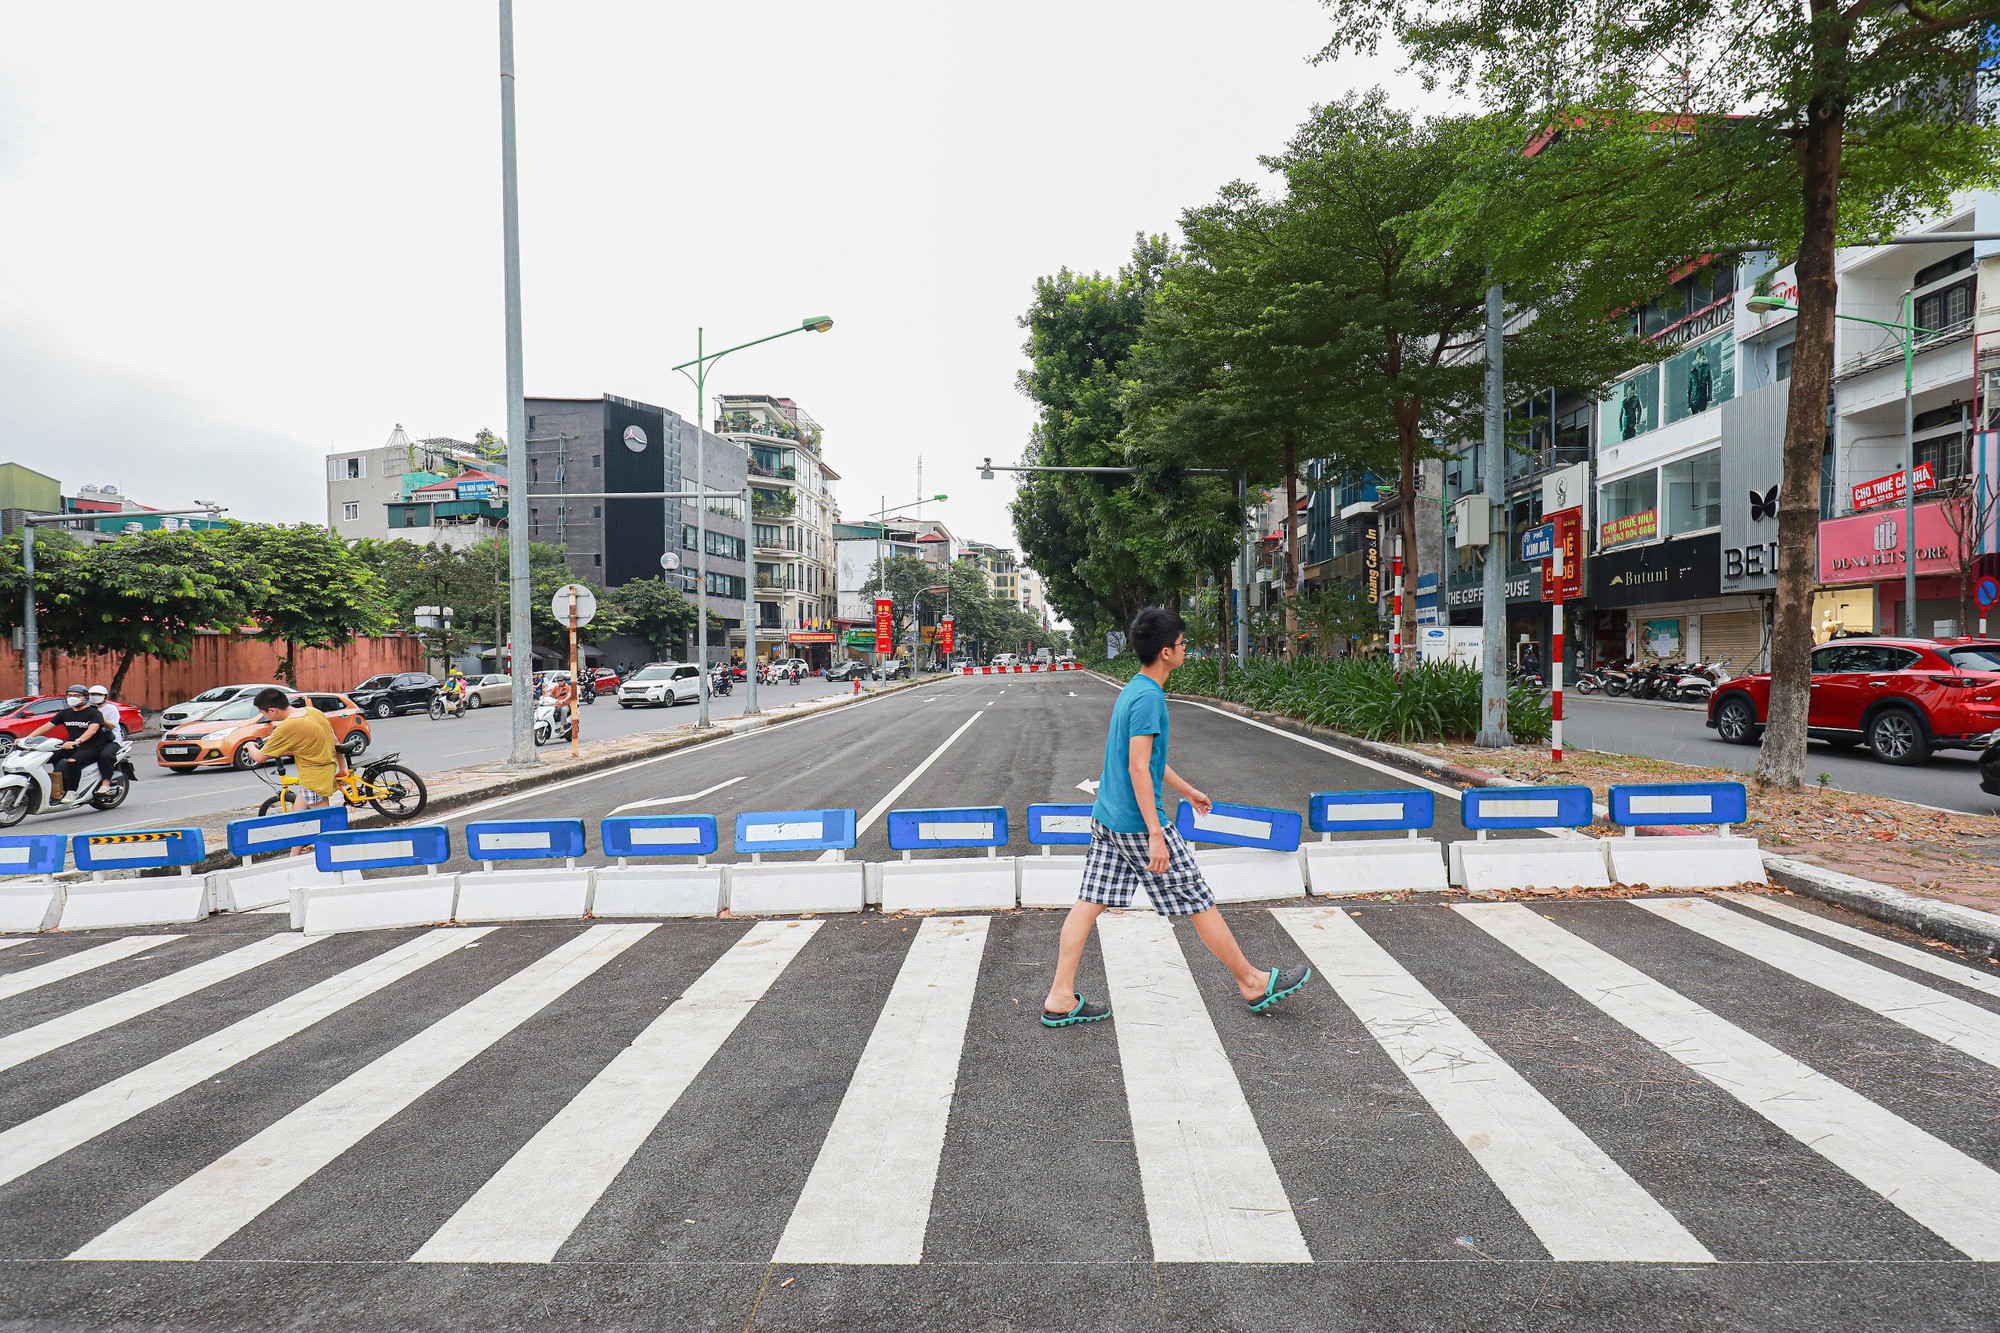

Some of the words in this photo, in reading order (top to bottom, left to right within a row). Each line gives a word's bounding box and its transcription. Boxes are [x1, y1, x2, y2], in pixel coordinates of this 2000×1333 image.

[1855, 486, 1871, 501] CHO
[1873, 477, 1893, 496] THUÊ
[1604, 523, 1617, 535] CHO
[1638, 510, 1653, 525] NHÀ
[1366, 528, 1377, 539] In
[1602, 537, 1612, 546] LH:
[1613, 531, 1624, 542] 093
[1526, 542, 1538, 556] KIM
[1540, 537, 1550, 553] MÃ
[1899, 546, 1949, 562] SORE
[1366, 548, 1377, 568] Cáo
[1625, 566, 1668, 586] Butuni
[1448, 590, 1460, 605] THE
[1462, 587, 1484, 604] COFF
[1504, 580, 1530, 598] OUSE
